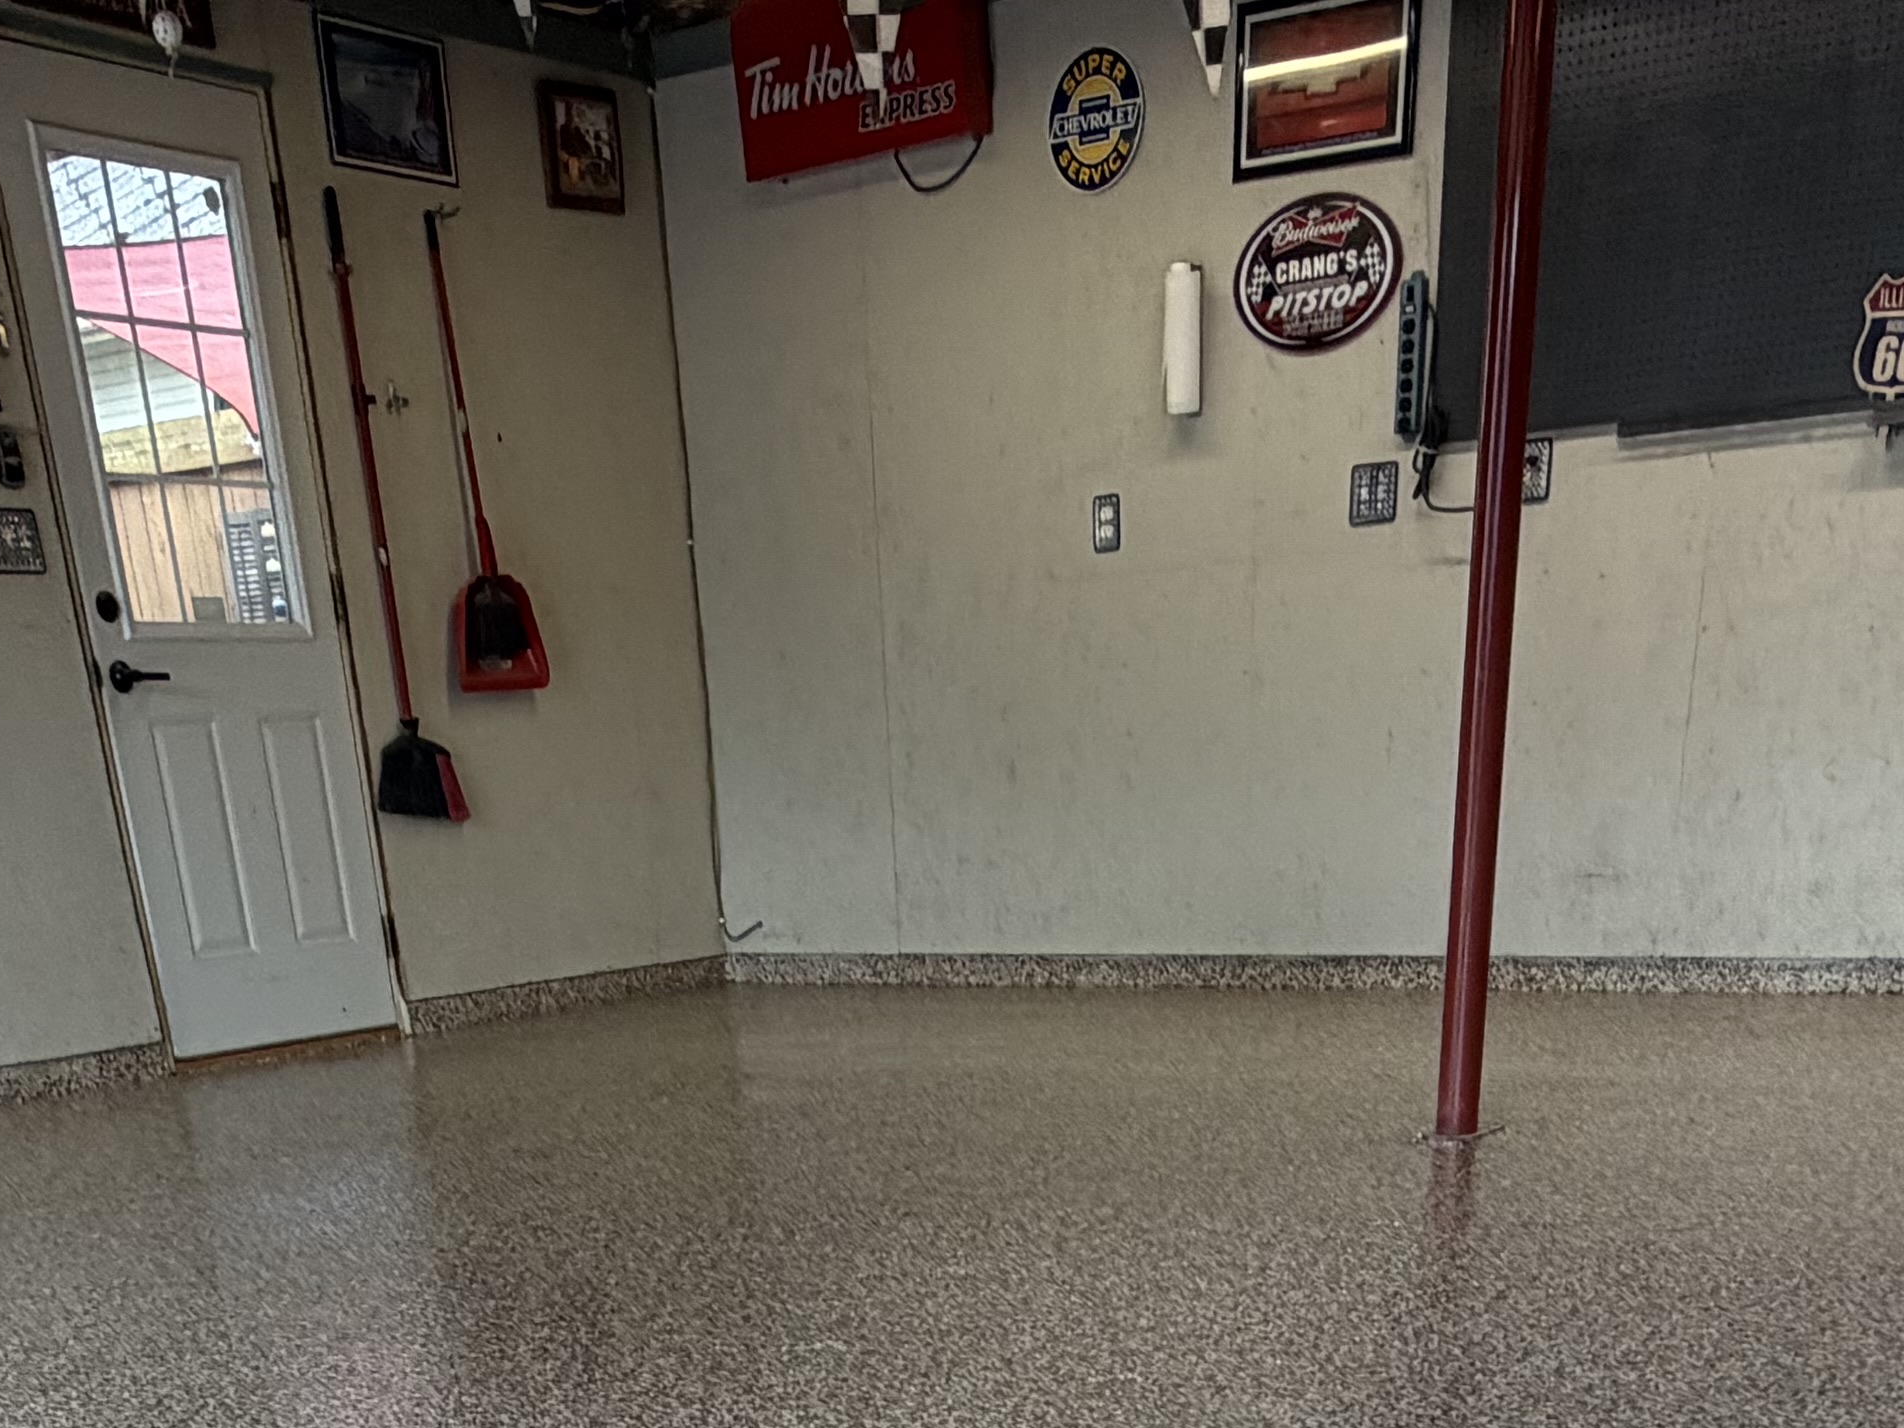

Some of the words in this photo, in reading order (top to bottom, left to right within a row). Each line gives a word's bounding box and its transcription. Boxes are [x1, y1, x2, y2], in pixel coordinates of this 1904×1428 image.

[745, 56, 799, 120] Tim
[1062, 53, 1127, 97] SUPER
[1055, 105, 1135, 137] CHEVROLET
[1059, 139, 1131, 186] SERVICE
[1265, 279, 1369, 321] PITSTOP
